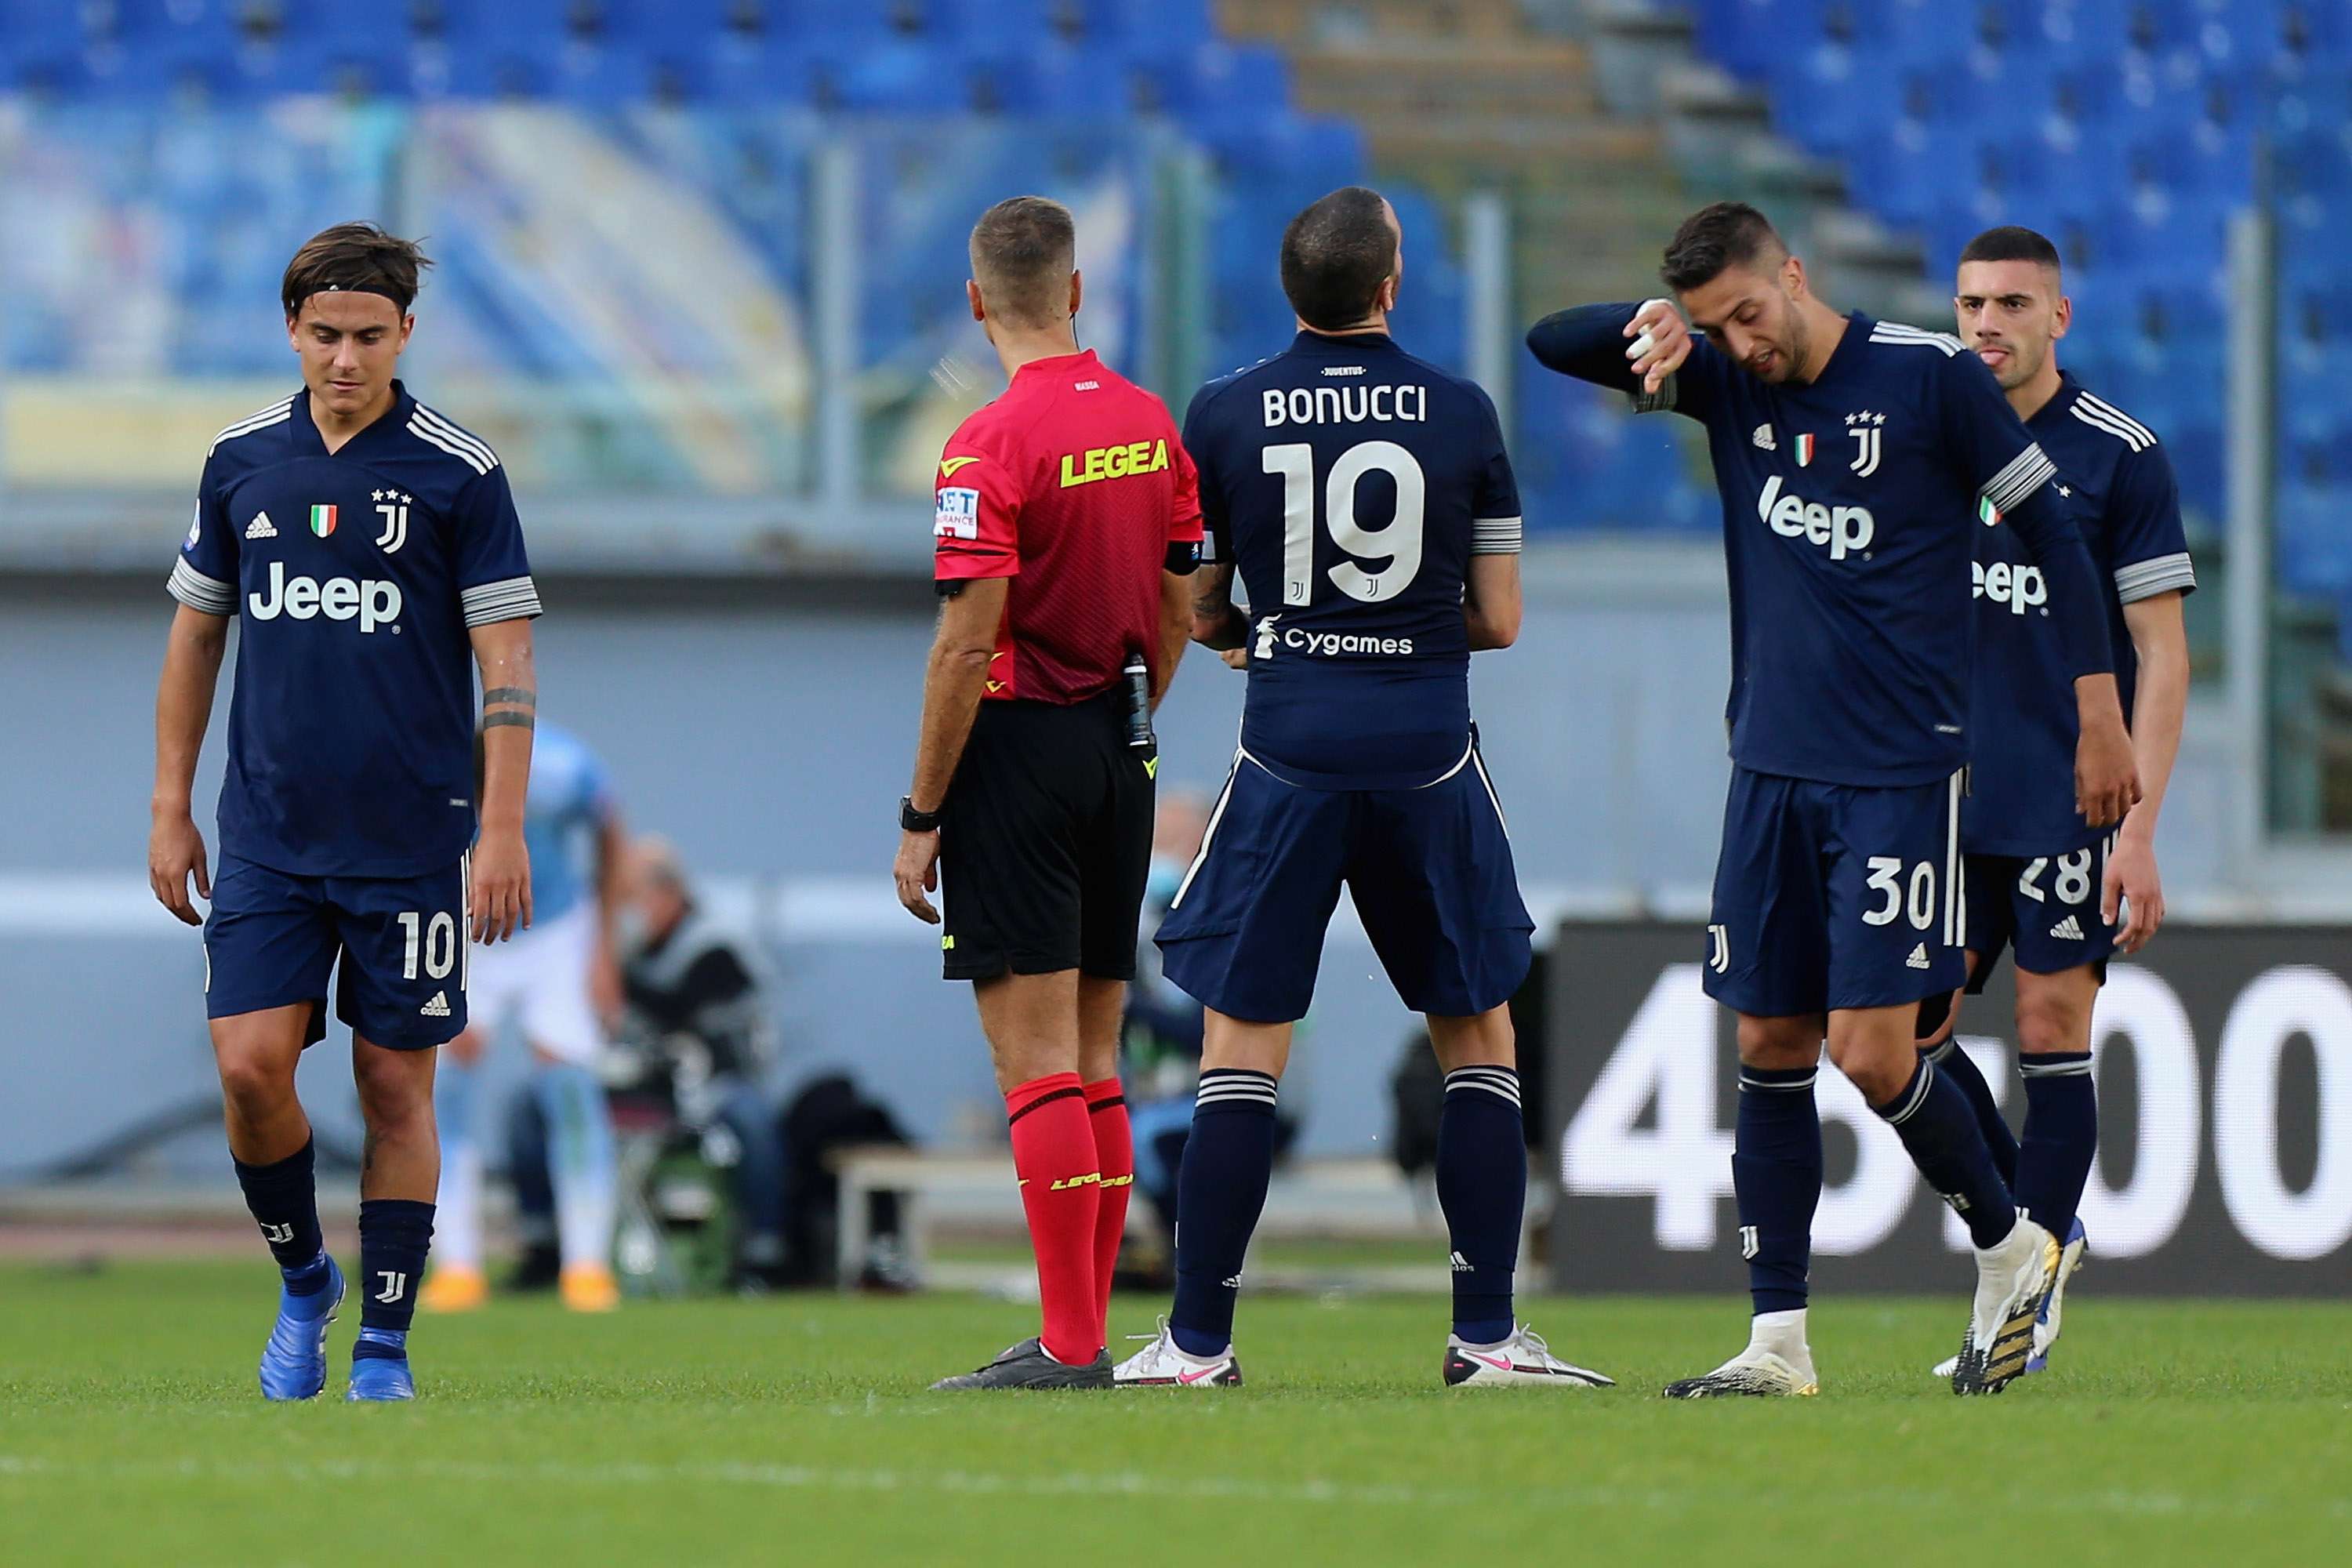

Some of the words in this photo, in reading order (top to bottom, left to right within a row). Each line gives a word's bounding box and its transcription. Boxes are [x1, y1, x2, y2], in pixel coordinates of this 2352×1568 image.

[1262, 385, 1427, 427] BONUCCI
[1059, 437, 1170, 489] LEGEA
[245, 527, 278, 539] adidas
[1261, 440, 1425, 607] 19
[249, 561, 402, 633] Jeep
[1284, 628, 1414, 655] Cygames
[1861, 856, 1936, 931] 30
[397, 911, 455, 980] 10
[419, 1007, 452, 1016] adidas
